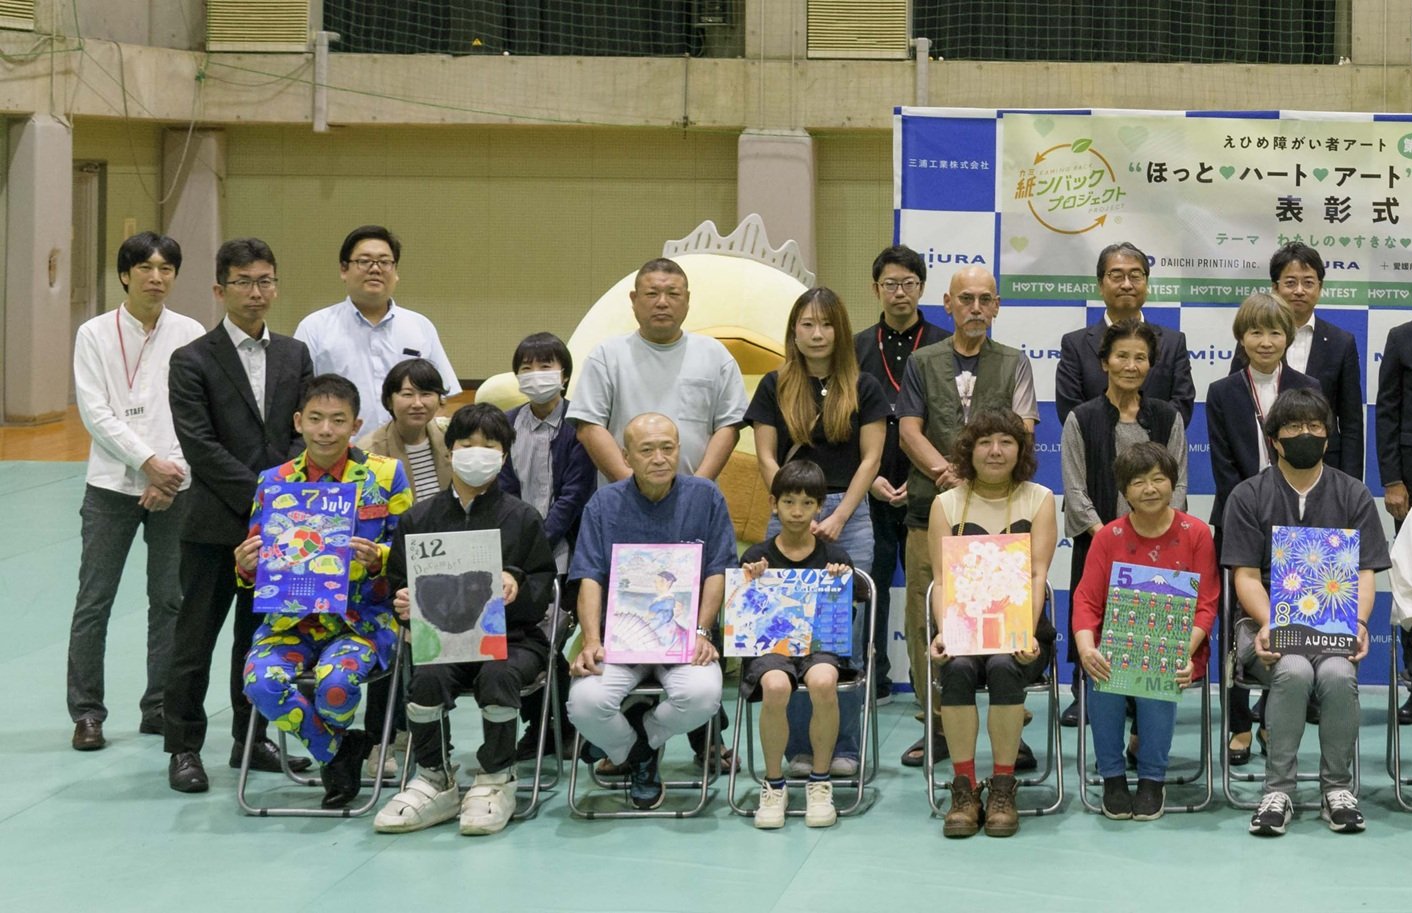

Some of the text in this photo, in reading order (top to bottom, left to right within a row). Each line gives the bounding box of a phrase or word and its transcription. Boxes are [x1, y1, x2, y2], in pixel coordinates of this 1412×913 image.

[1223, 135, 1386, 152] えひめ障がい者アート
[908, 158, 990, 170] 三浦工業株式会社
[1047, 186, 1127, 212] プロジェクト
[1275, 195, 1400, 225] 表彰式
[1215, 233, 1260, 246] テーマ
[1160, 257, 1260, 269] DAIICHI PRINTING Inc.
[1058, 283, 1097, 293] HEART
[125, 406, 145, 417] STAFF
[301, 489, 321, 509] 7
[320, 495, 352, 515] July
[418, 538, 447, 560] 12
[1117, 566, 1133, 588] 5
[1275, 601, 1291, 627] 8
[665, 629, 695, 664] 4
[1304, 634, 1353, 648] AUGUST
[1145, 677, 1178, 693] Ma
